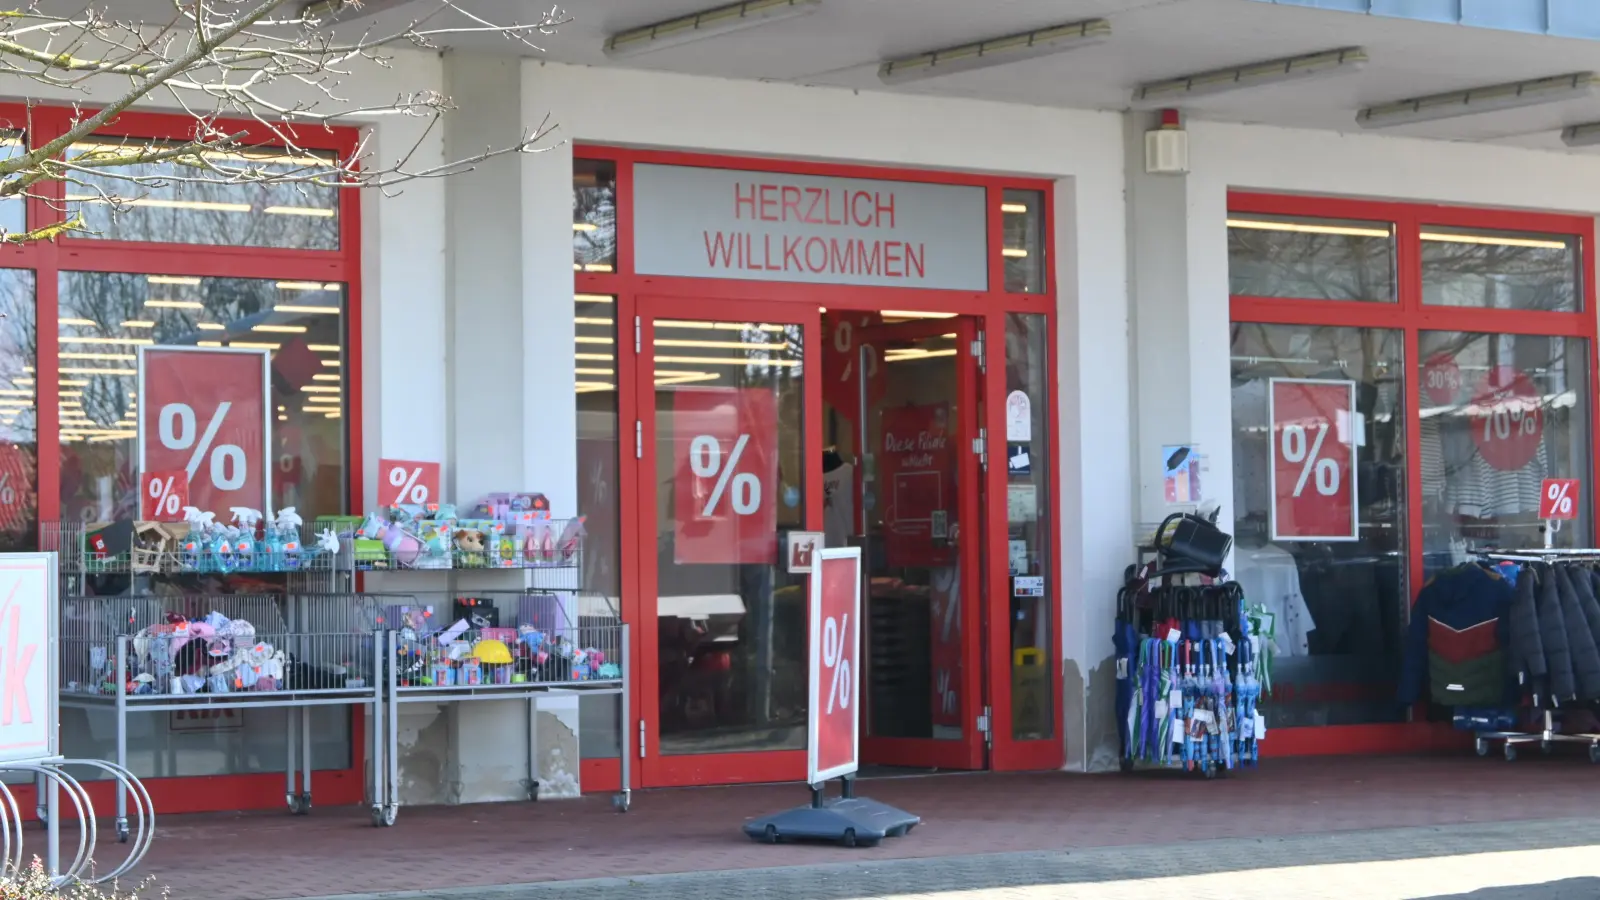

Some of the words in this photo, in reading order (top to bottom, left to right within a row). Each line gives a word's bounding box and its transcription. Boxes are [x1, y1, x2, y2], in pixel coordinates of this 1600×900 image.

[734, 182, 895, 229] HERZLICH
[703, 230, 925, 278] WILLKOMMEN
[1427, 370, 1458, 389] 30%
[158, 401, 247, 491] %
[1481, 408, 1536, 442] 70%
[689, 433, 762, 517] %
[1281, 423, 1340, 497] %
[149, 476, 180, 516] %
[389, 467, 428, 505] %
[1547, 482, 1573, 514] %
[823, 613, 851, 715] %
